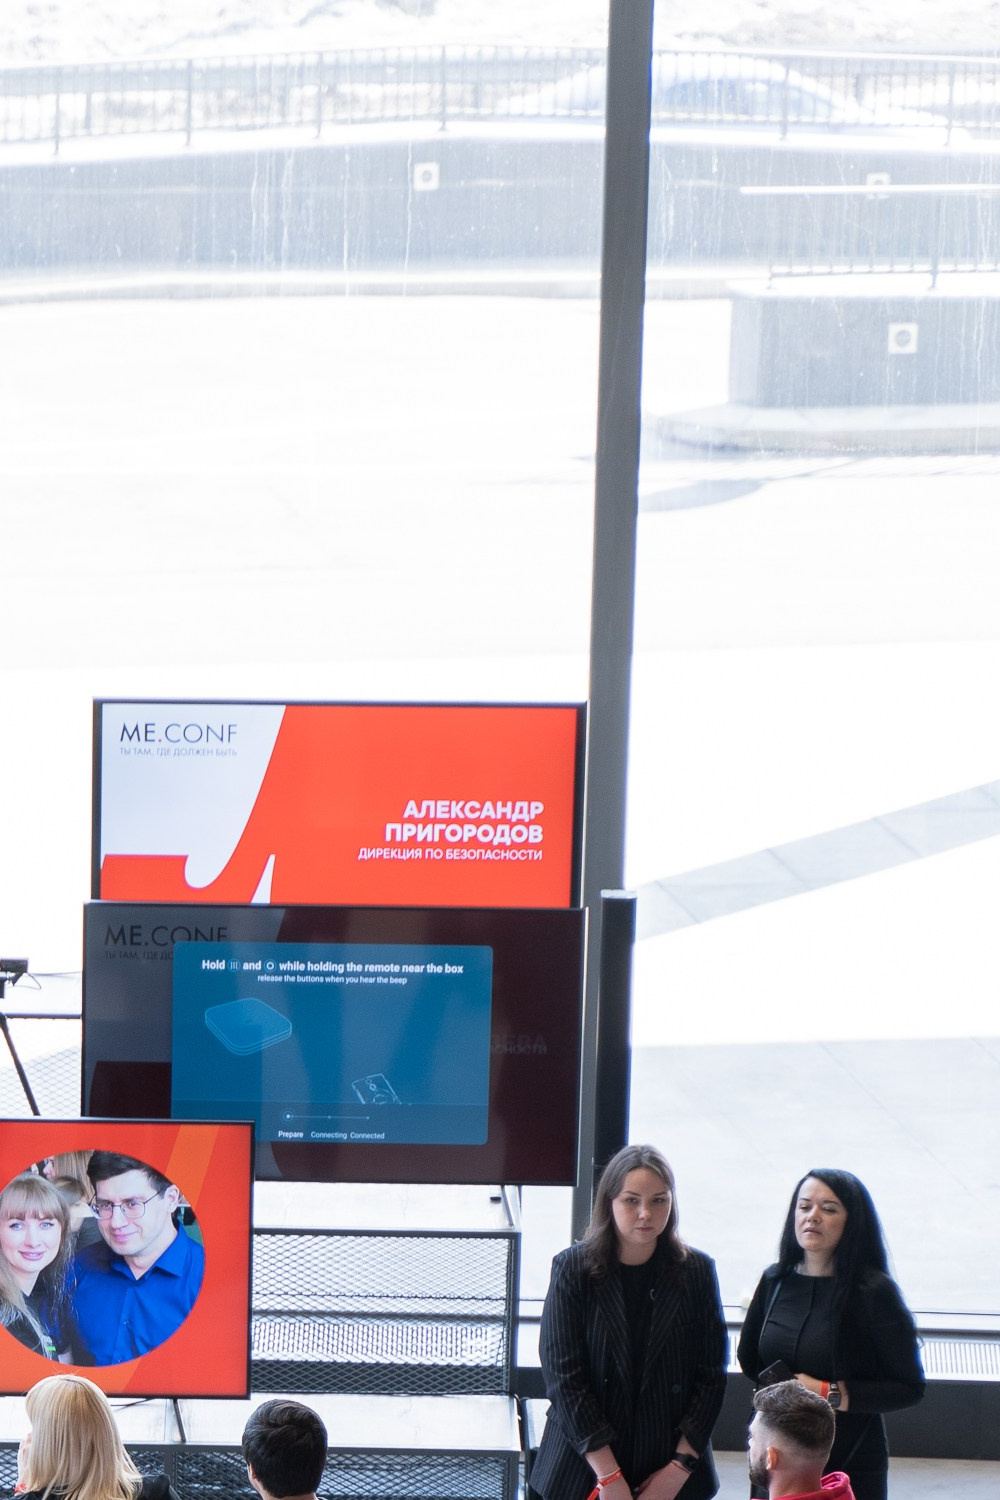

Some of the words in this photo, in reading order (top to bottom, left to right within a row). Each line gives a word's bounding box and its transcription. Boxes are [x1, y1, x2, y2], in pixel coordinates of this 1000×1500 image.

[120, 722, 238, 743] ME.CONF
[120, 748, 131, 756] ТЫ
[157, 748, 170, 757] ГДЕ
[173, 748, 213, 757] ДОЛЖЕН
[216, 748, 238, 757] БЫТЬ
[403, 800, 544, 822] АЛЕКСАНДР
[385, 823, 543, 846] ПРИГОРОДОВ
[358, 848, 422, 860] ДИРЕКЦИЯ
[425, 848, 443, 860] ПО
[445, 849, 542, 860] БЕЗОПАСНОСТИ
[202, 960, 225, 970] Hold
[243, 960, 262, 970] and
[279, 961, 305, 971] while
[307, 961, 344, 974] holding
[346, 962, 362, 972] the
[365, 963, 400, 973] remote
[402, 965, 425, 973] near
[426, 963, 443, 973] the
[445, 963, 464, 974] box
[257, 974, 282, 982] release
[284, 974, 296, 982] the
[297, 974, 323, 983] buttons
[325, 975, 344, 983] when
[346, 976, 359, 985] you
[360, 976, 375, 984] hear
[376, 976, 389, 984] the
[390, 976, 408, 986] beep
[278, 1131, 304, 1139] Prepare
[310, 1131, 347, 1140] Connecting
